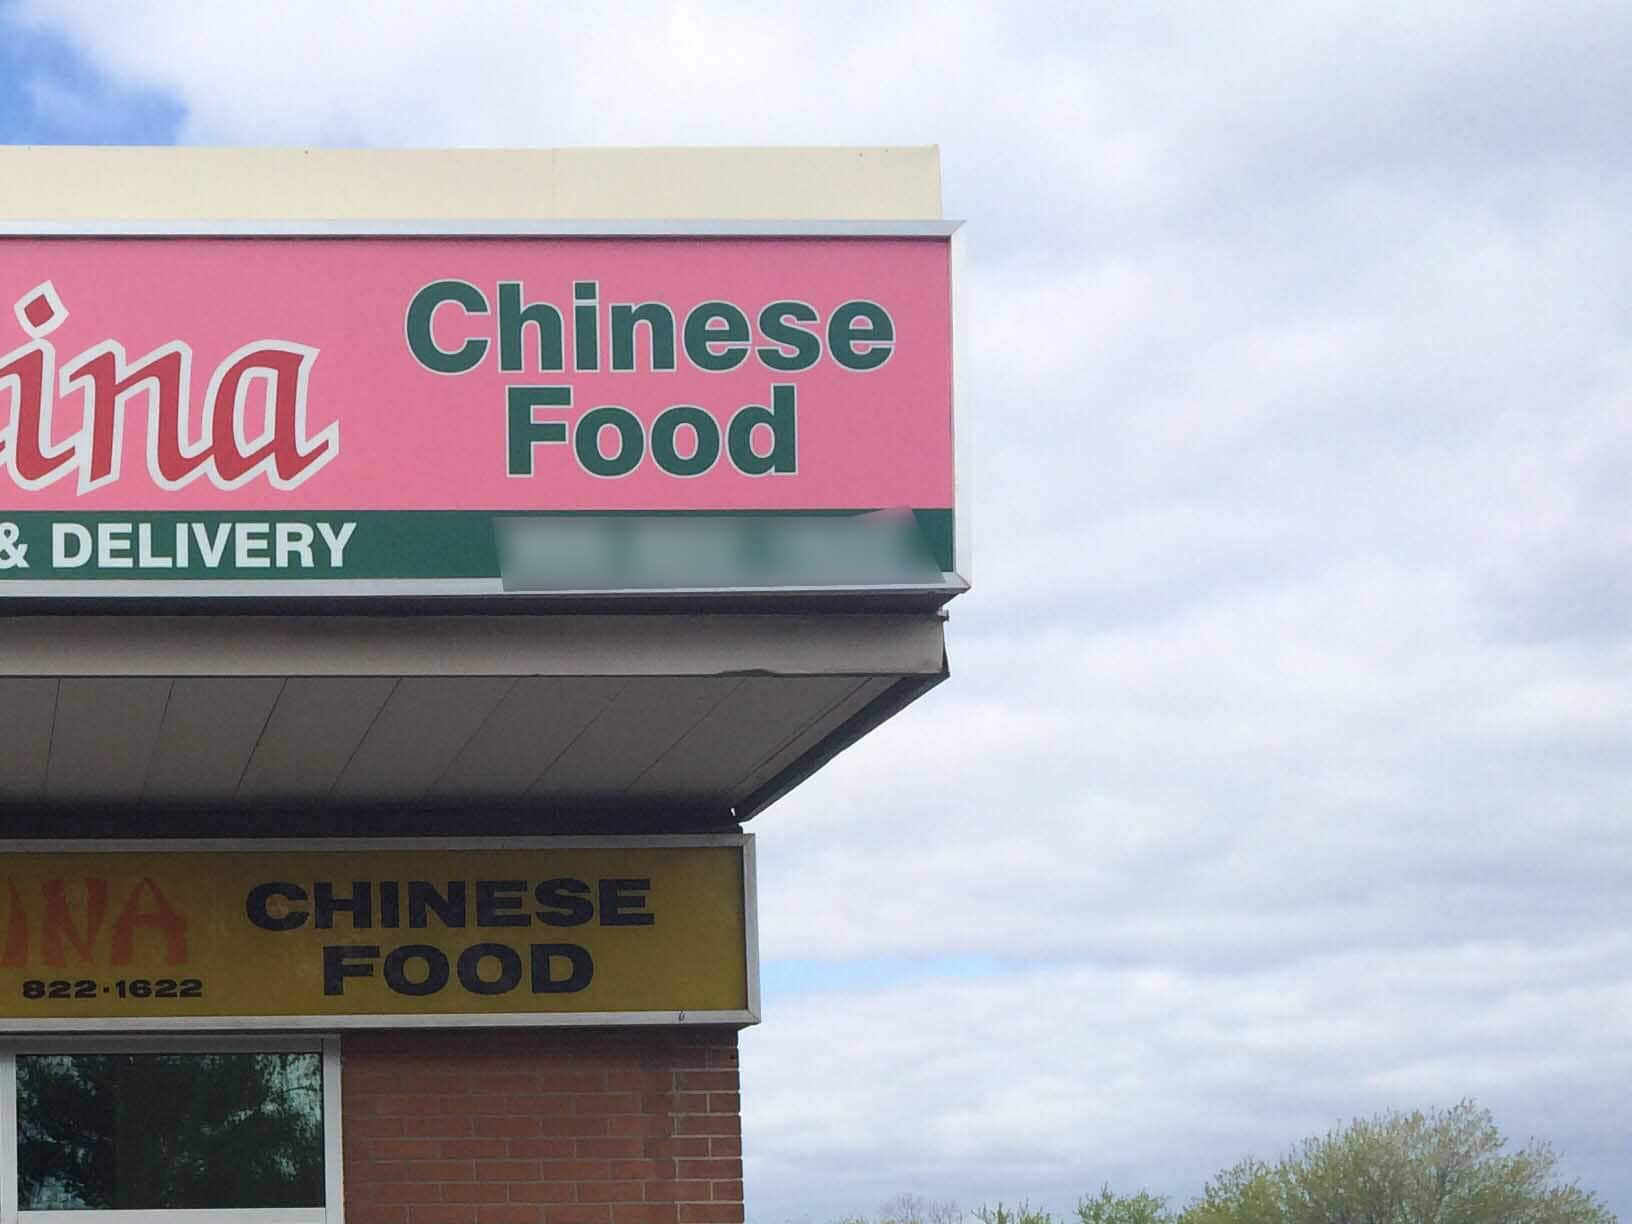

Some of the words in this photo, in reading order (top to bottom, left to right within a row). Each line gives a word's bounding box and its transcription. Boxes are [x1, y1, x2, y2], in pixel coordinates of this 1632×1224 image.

[404, 279, 896, 375] Chinese
[505, 383, 799, 478] Food
[52, 521, 358, 570] DELIVERY
[246, 878, 655, 932] CHINESE
[322, 943, 594, 997] FOOD
